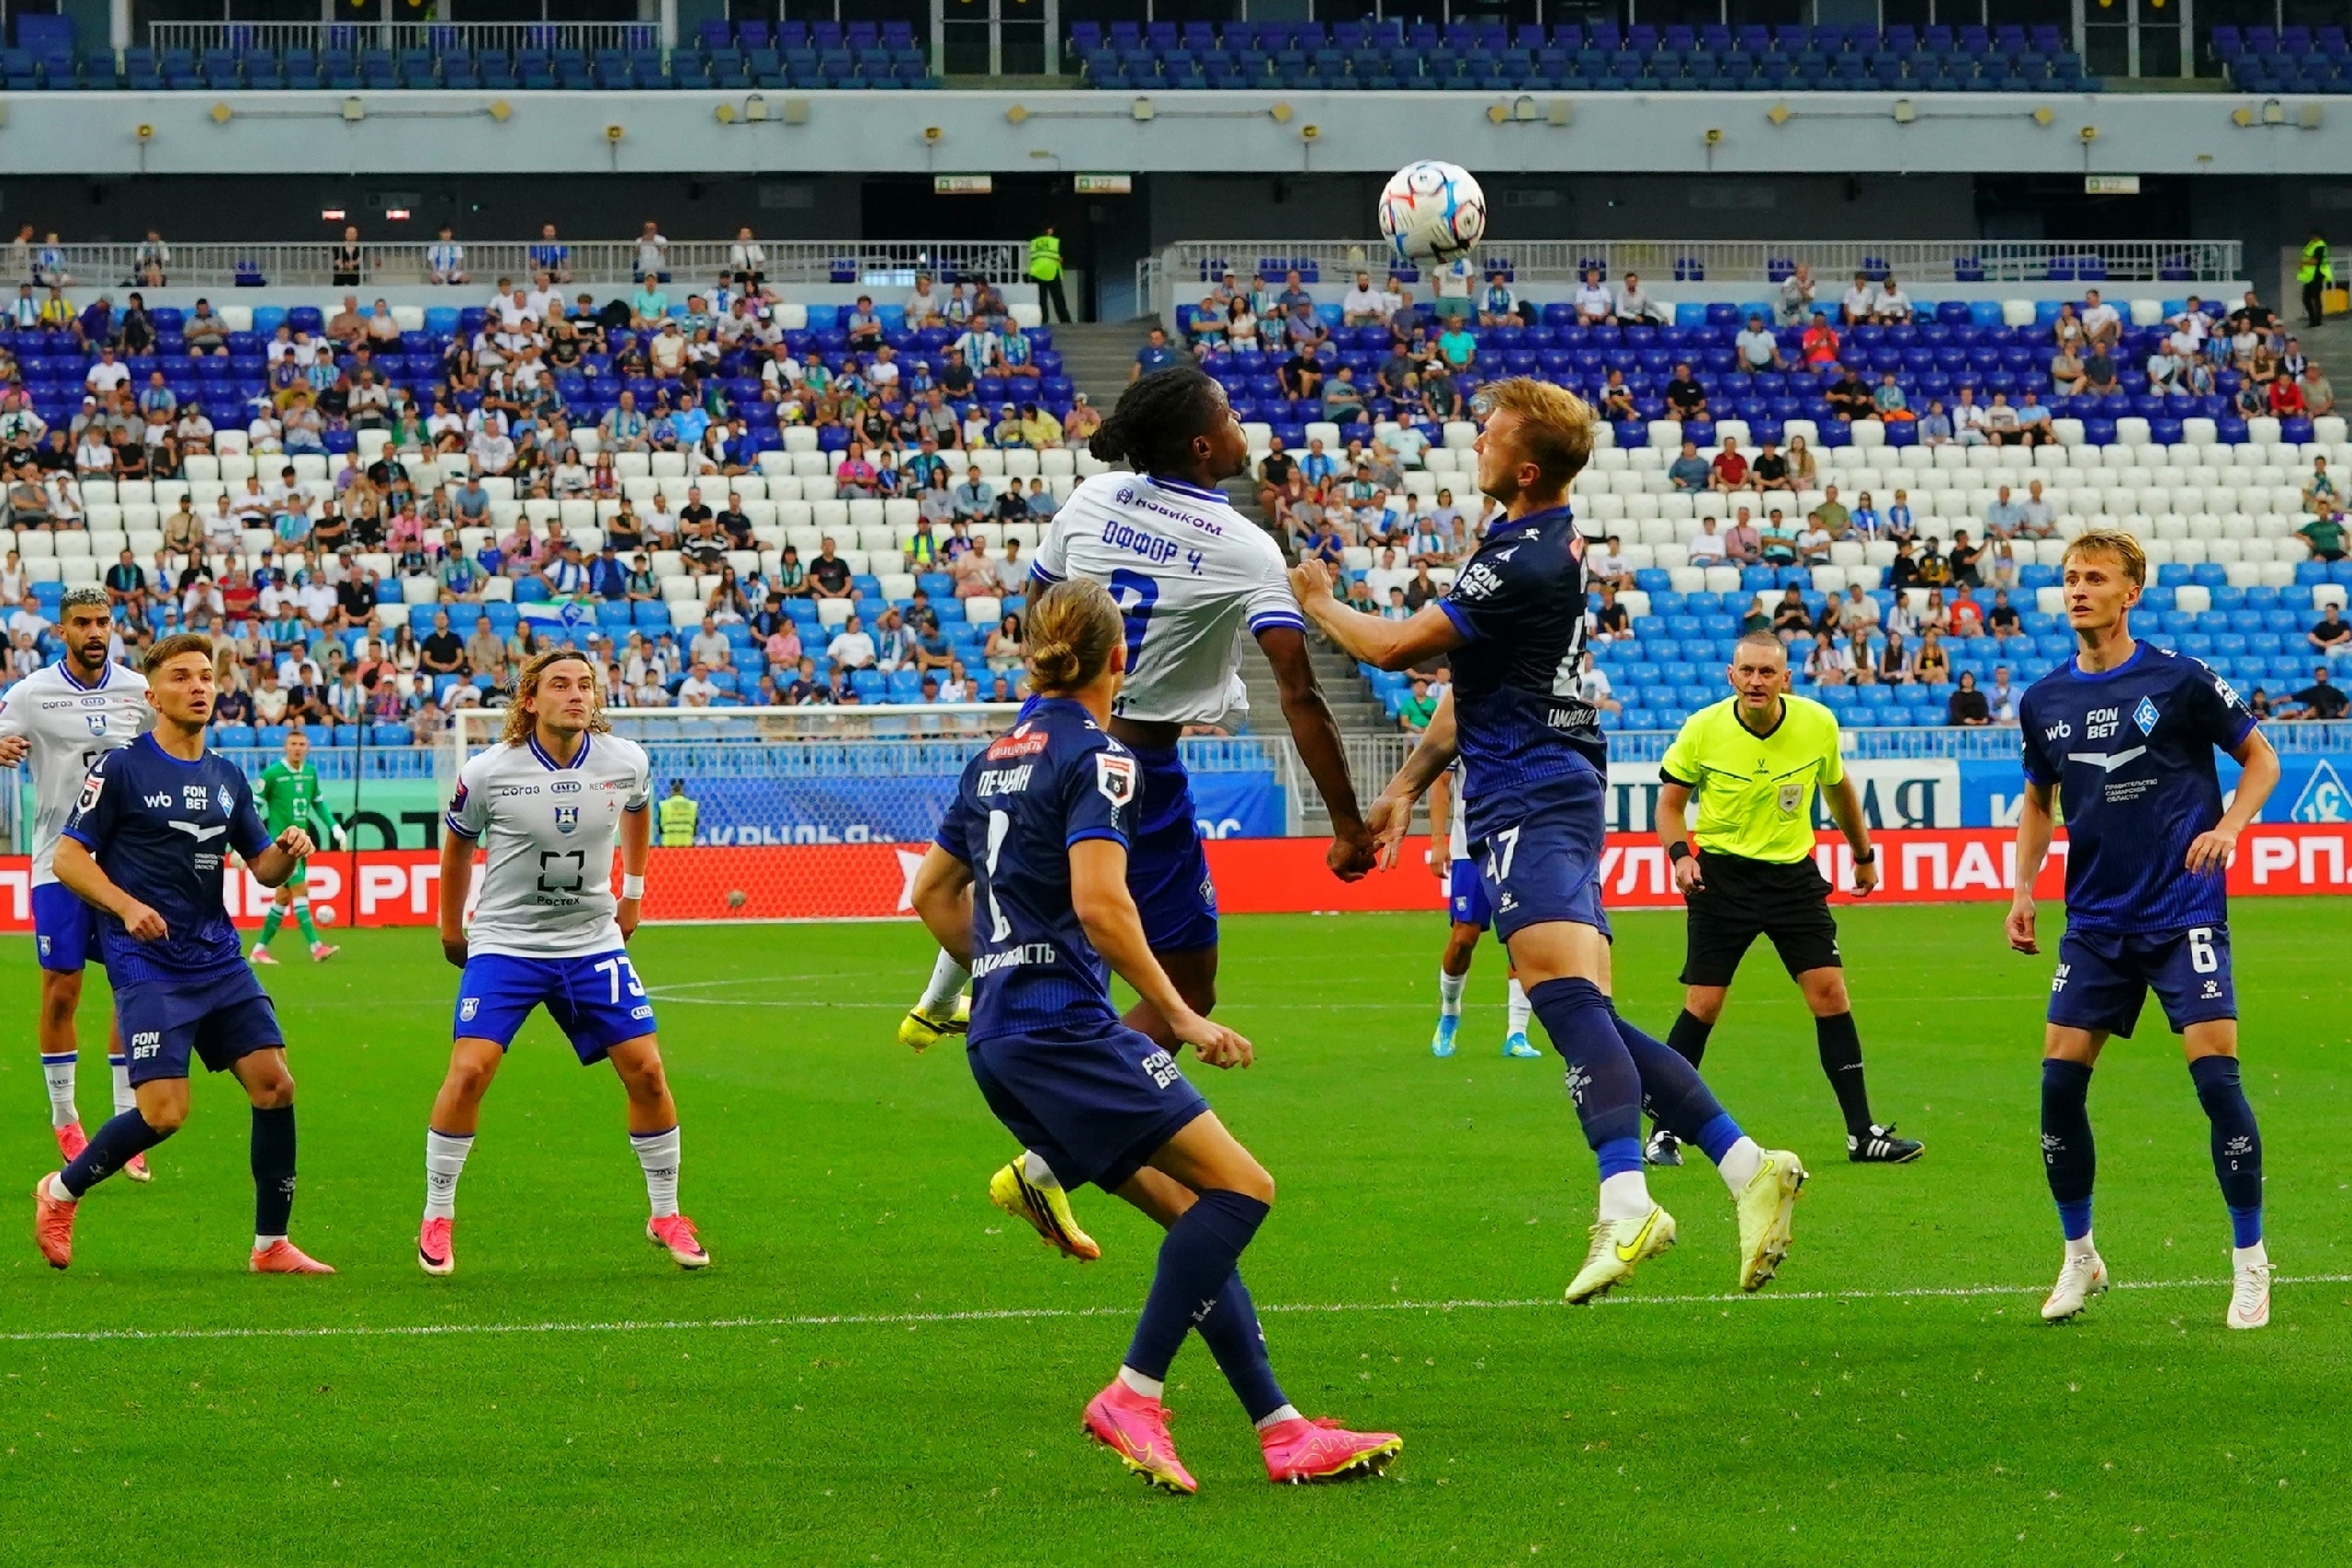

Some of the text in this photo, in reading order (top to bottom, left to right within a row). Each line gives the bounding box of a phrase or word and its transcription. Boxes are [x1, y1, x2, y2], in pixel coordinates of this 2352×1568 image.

[1136, 498, 1223, 536] НОВИКОМ
[1102, 520, 1178, 564] ОФФОР
[2086, 707, 2120, 726] FON
[2045, 720, 2072, 741] wb
[2087, 721, 2120, 739] BET
[143, 791, 173, 808] wb
[183, 785, 207, 798] FON
[186, 798, 209, 810] BET
[2252, 837, 2352, 885] РП
[537, 896, 581, 907] Ростех
[2188, 927, 2218, 974] 6
[594, 956, 646, 1004] 73
[2052, 978, 2068, 993] ET
[131, 1032, 160, 1046] FON
[133, 1044, 161, 1060] BET
[1141, 1050, 1172, 1076] FON
